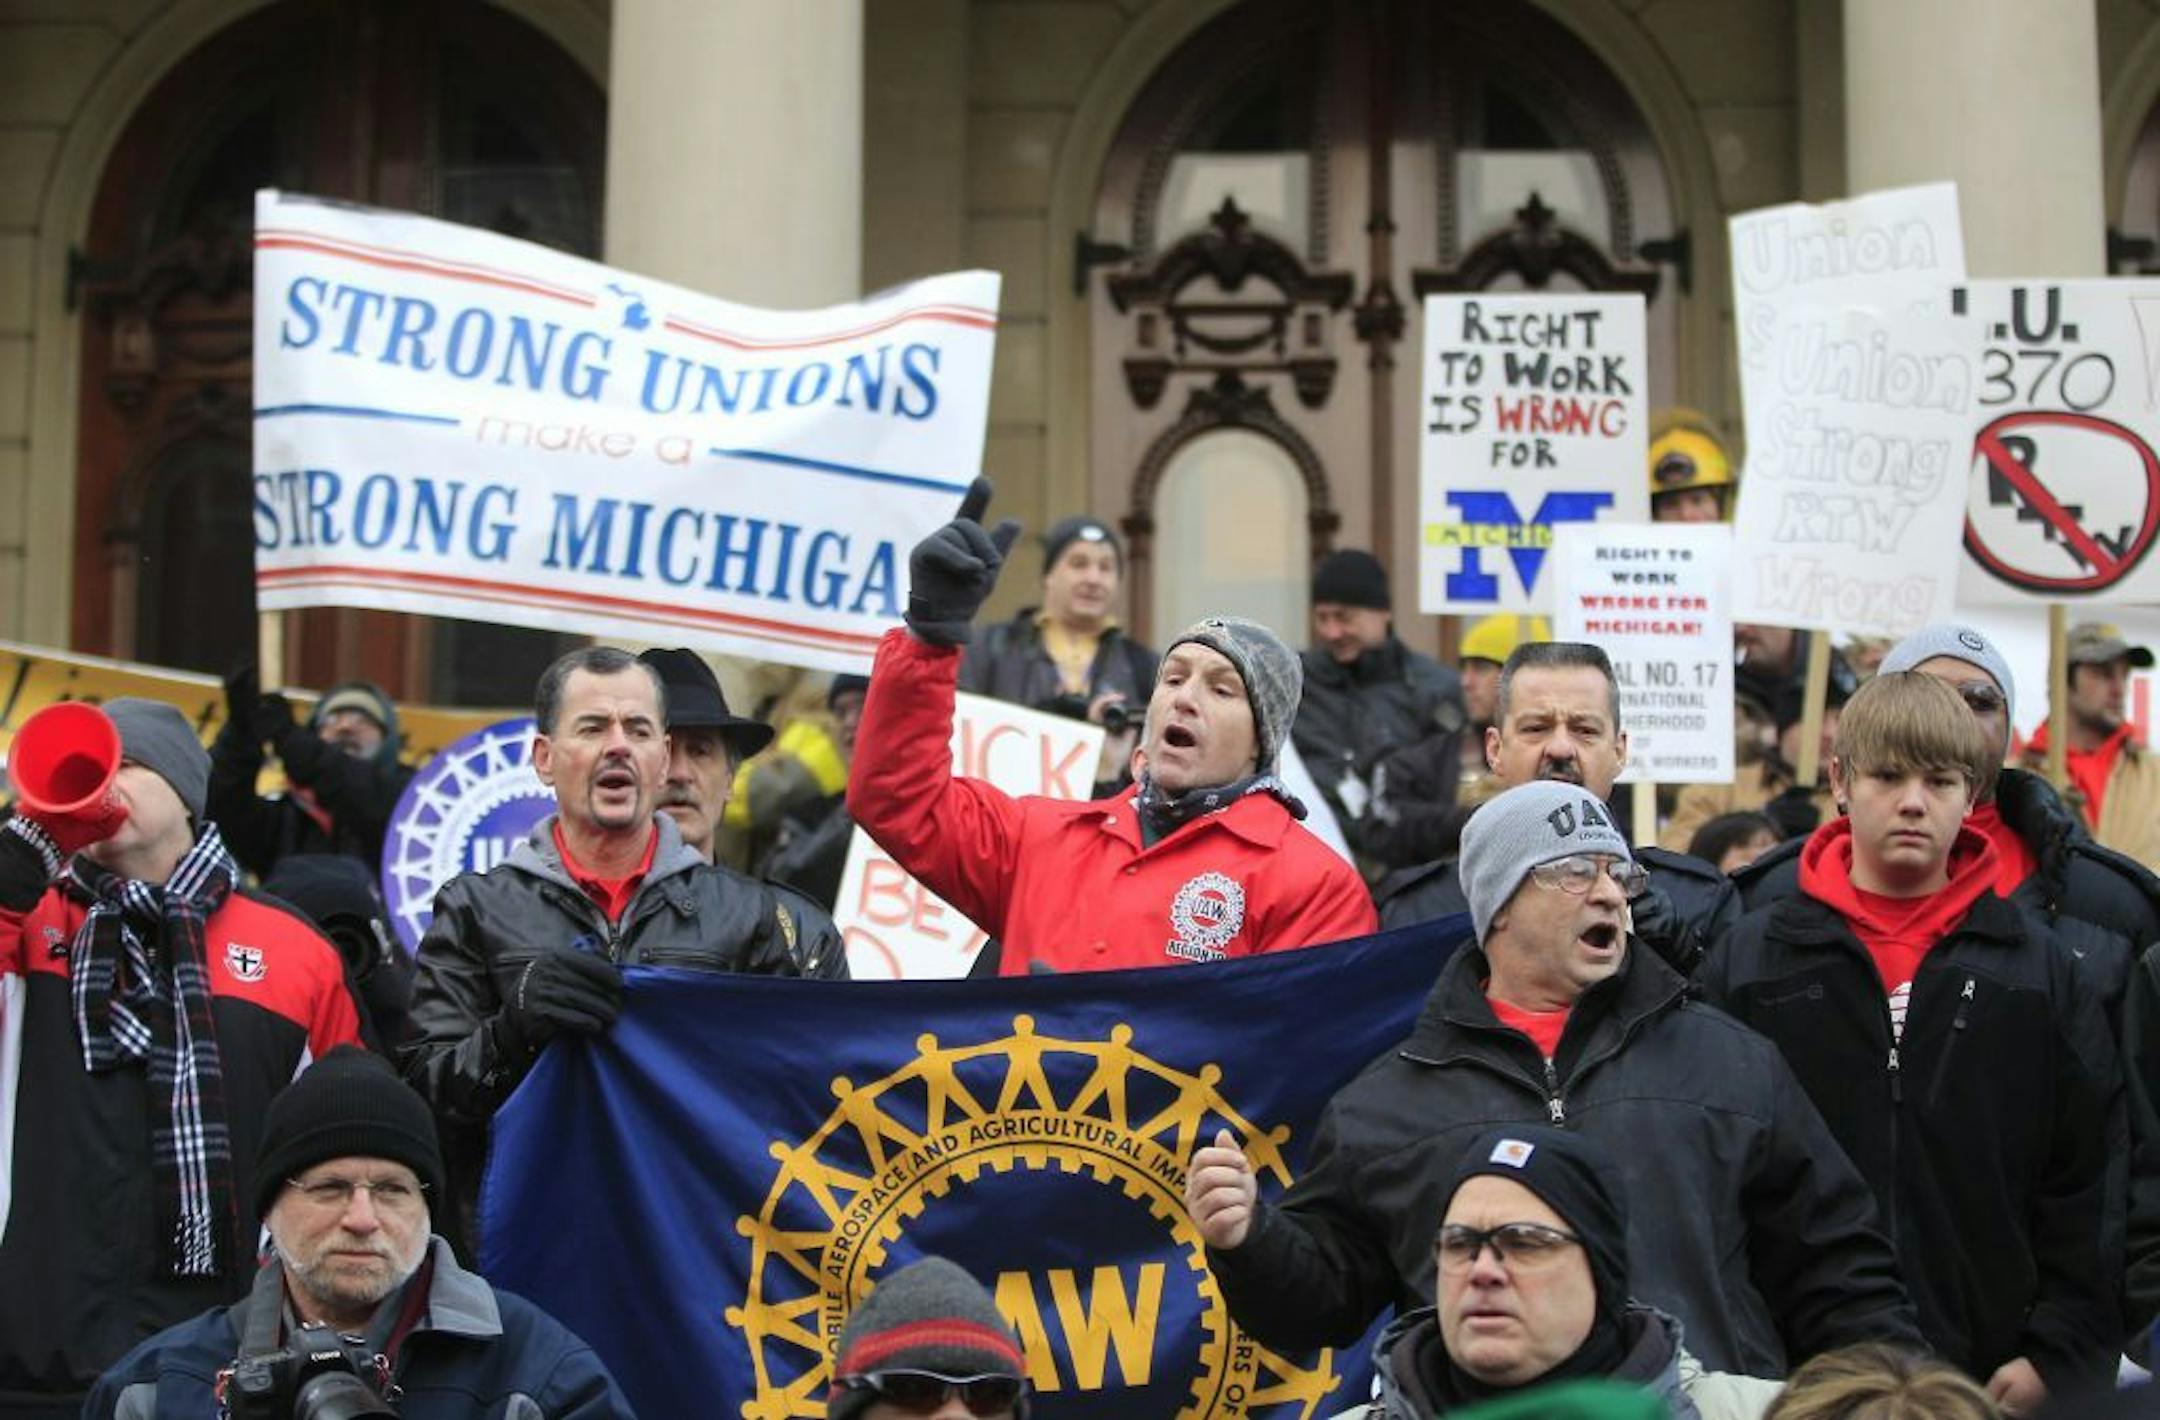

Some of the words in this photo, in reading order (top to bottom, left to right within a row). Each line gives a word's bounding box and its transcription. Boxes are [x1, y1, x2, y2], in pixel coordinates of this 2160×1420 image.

[1738, 216, 1937, 295] Union
[281, 275, 613, 403] STRONG
[639, 341, 942, 421] UNIONS
[1461, 301, 1601, 349] RIGHT
[1440, 351, 1482, 385] TO
[1503, 351, 1633, 396] WORK
[1781, 322, 1972, 414] Union
[1979, 350, 2116, 412] 370
[477, 412, 635, 458] make
[655, 432, 693, 466] a
[1429, 396, 1481, 434] IS
[1495, 396, 1628, 439] WRONG
[1490, 439, 1558, 469] FOR
[1753, 400, 1951, 505] Strong
[254, 469, 518, 563] STRONG
[1772, 491, 1917, 555] RTW
[1596, 547, 1659, 561] RIGHT
[1668, 548, 1692, 561] TO
[1612, 572, 1677, 585] WORK
[1580, 595, 1659, 609] WRONG
[1667, 596, 1706, 609] FOR
[1753, 552, 1938, 630] Wrong
[1621, 691, 1708, 708] NATIONAL
[1645, 660, 1685, 688] NO.
[1694, 660, 1720, 688] 17
[827, 1164, 908, 1280] AEROSPACE
[911, 1134, 958, 1170] AND
[970, 1115, 1145, 1162] AGRICULTURAL
[1222, 1384, 1245, 1416] OF
